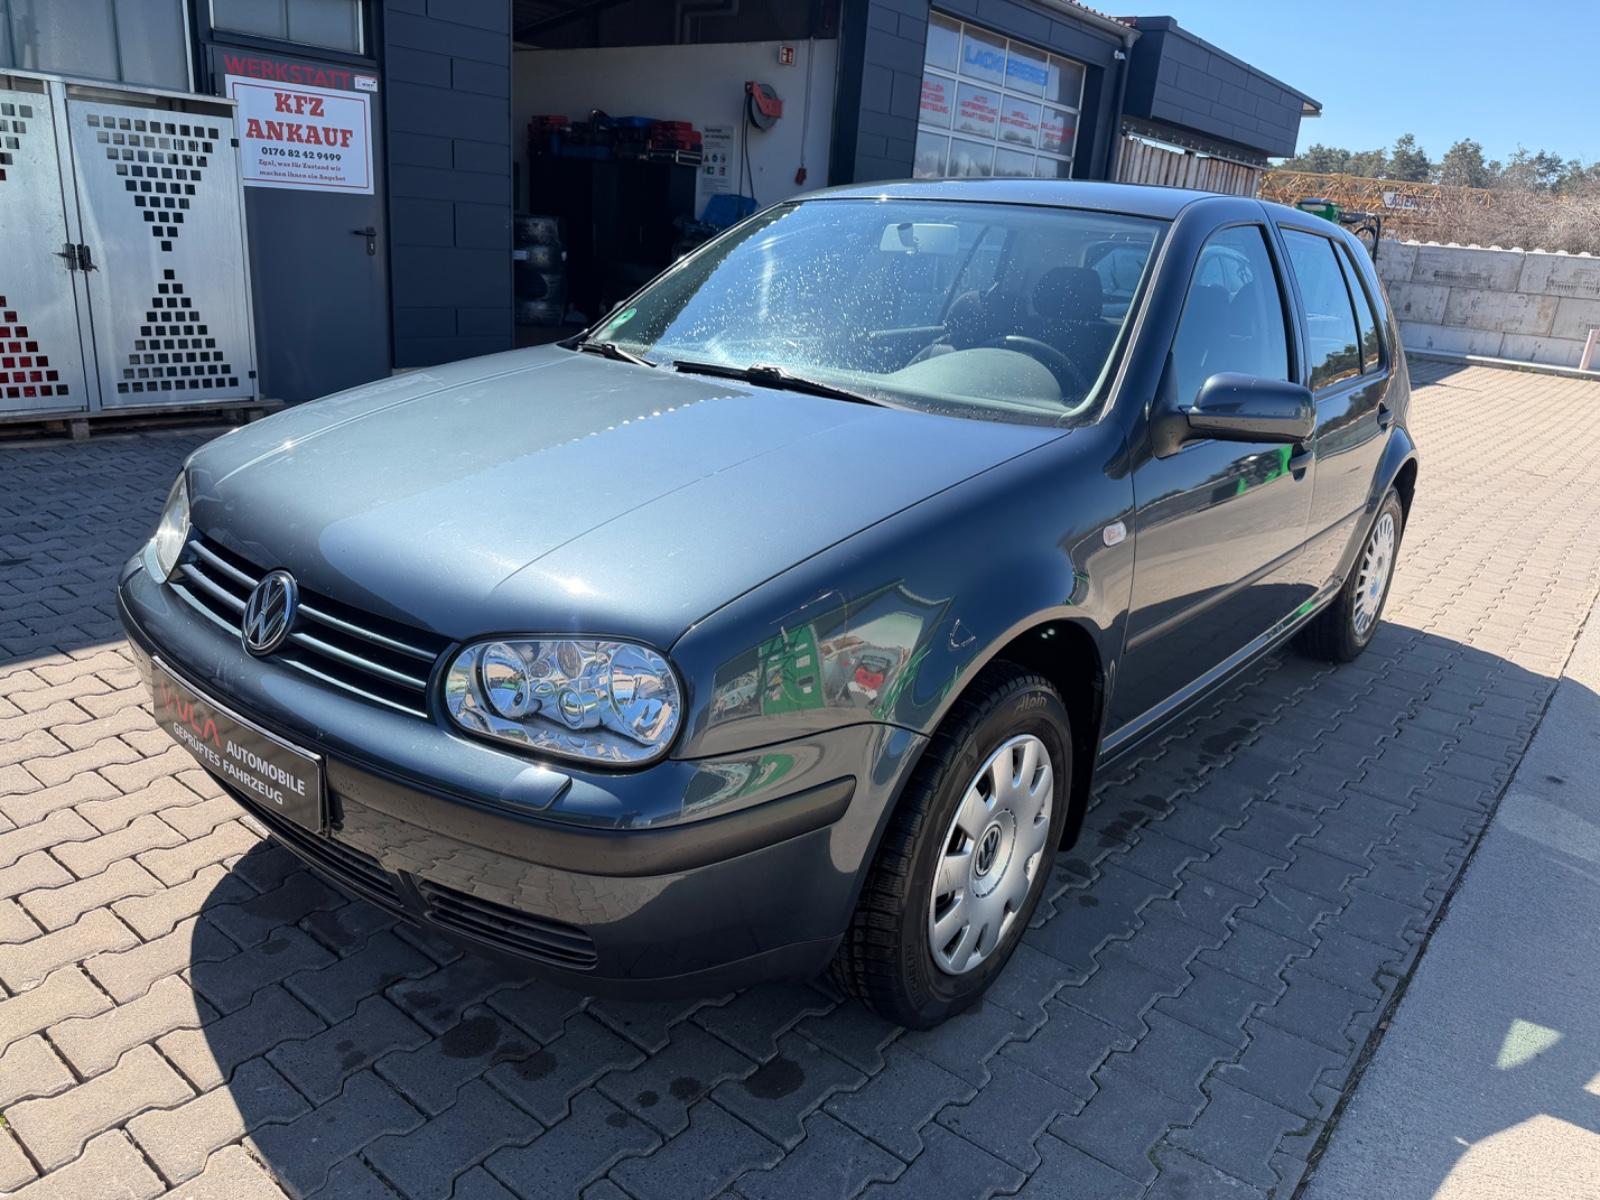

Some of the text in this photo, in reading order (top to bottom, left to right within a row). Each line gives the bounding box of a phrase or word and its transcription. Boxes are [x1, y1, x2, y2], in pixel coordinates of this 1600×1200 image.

[224, 53, 350, 90] WERKSTATT
[274, 92, 325, 118] KFZ
[246, 118, 353, 148] ANKAUF
[261, 146, 342, 161] 0176 82 42 9499
[302, 162, 329, 171] Zustand
[173, 722, 283, 806] GEPRÜFTES FAHRZEUG
[226, 740, 305, 796] AUTOMOBILE
